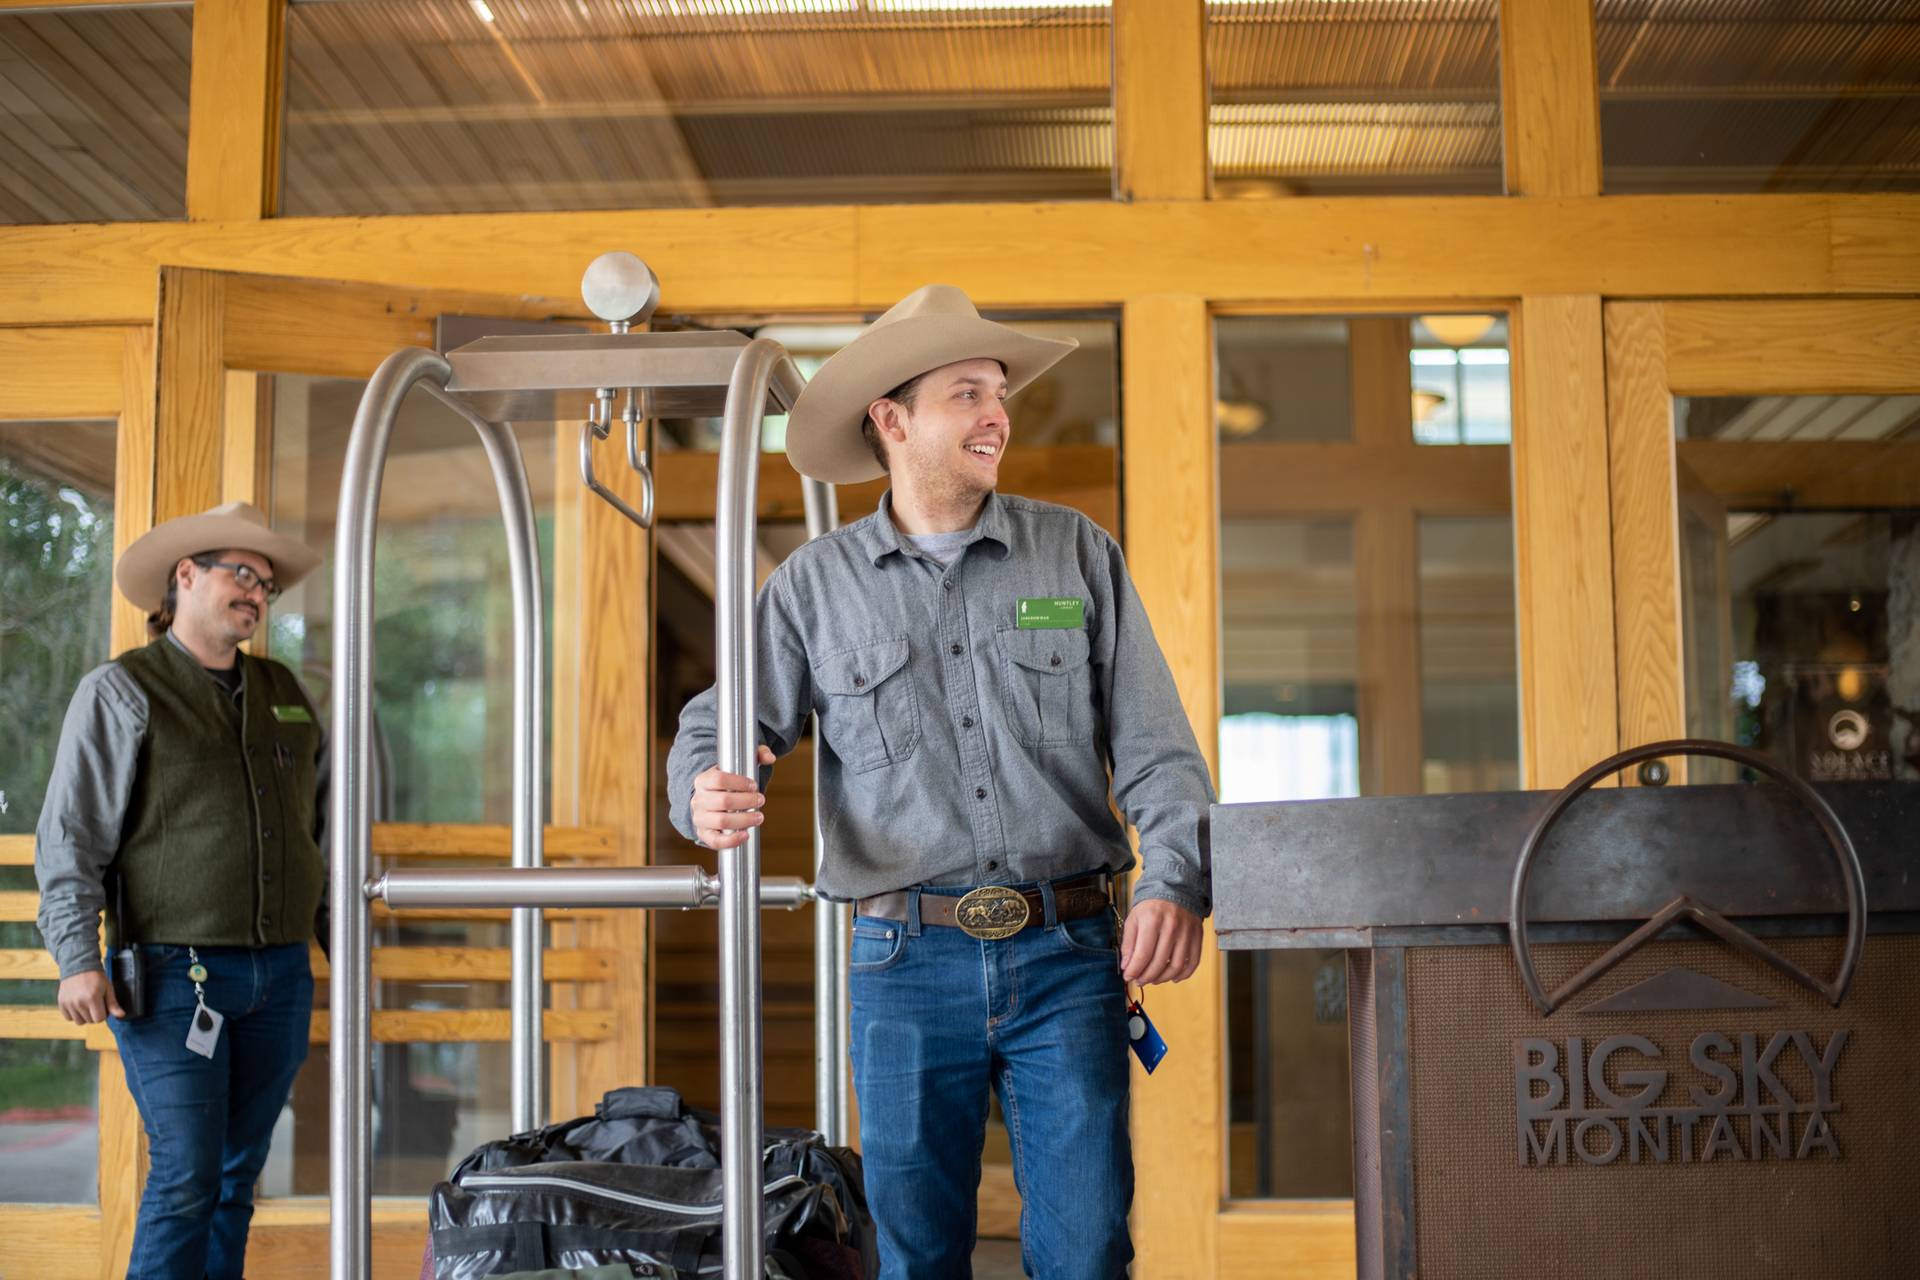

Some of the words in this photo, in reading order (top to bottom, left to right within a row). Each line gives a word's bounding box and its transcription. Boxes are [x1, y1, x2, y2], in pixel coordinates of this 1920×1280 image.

[1514, 1034, 1668, 1109] BIG
[1689, 1030, 1850, 1108] SKY
[1516, 1111, 1842, 1167] MONTANA
